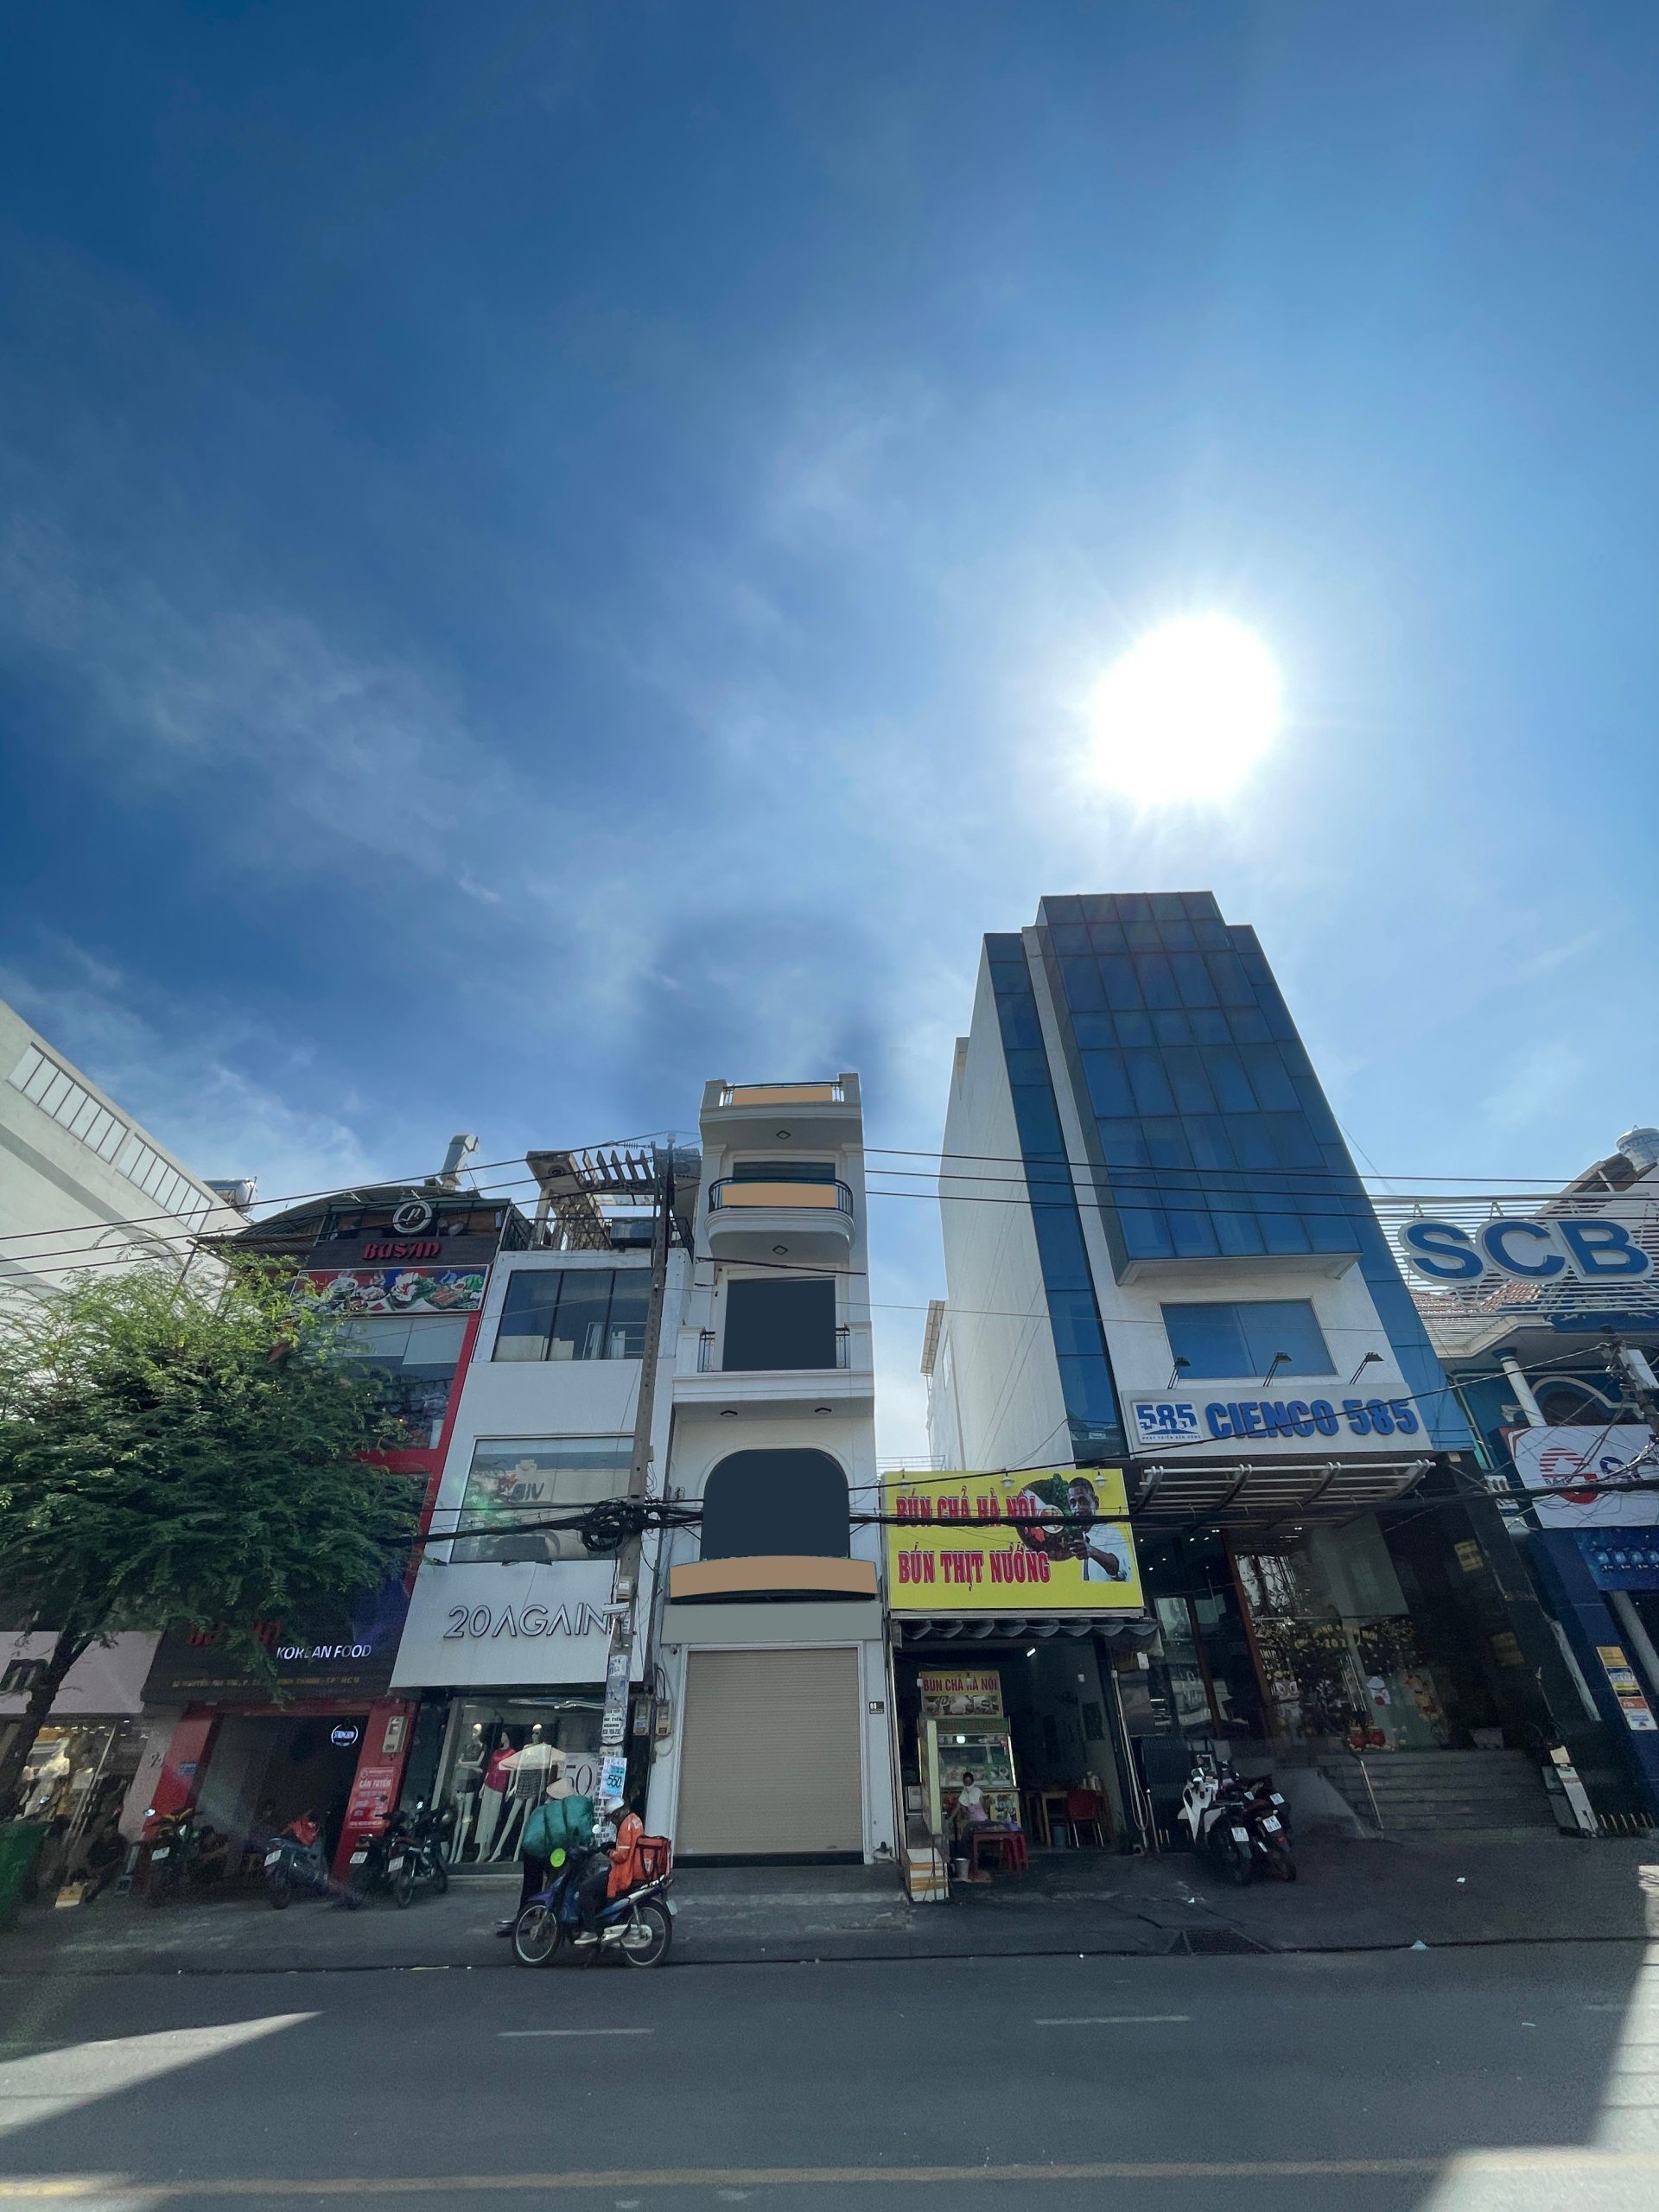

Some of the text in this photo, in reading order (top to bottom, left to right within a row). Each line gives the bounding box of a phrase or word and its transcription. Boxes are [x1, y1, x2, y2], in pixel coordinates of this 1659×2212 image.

[361, 1241, 442, 1260] BUSAN
[1406, 1220, 1649, 1279] SCB
[1135, 1403, 1199, 1431] 585
[1205, 1398, 1420, 1440] CIENCO 585
[895, 1487, 932, 1527] BÚN
[937, 1484, 971, 1527] CHẢ
[976, 1487, 1001, 1527] HÀ
[898, 1541, 1052, 1592] BÚN THỊT NƯỚNG
[334, 1644, 372, 1658] FOOD
